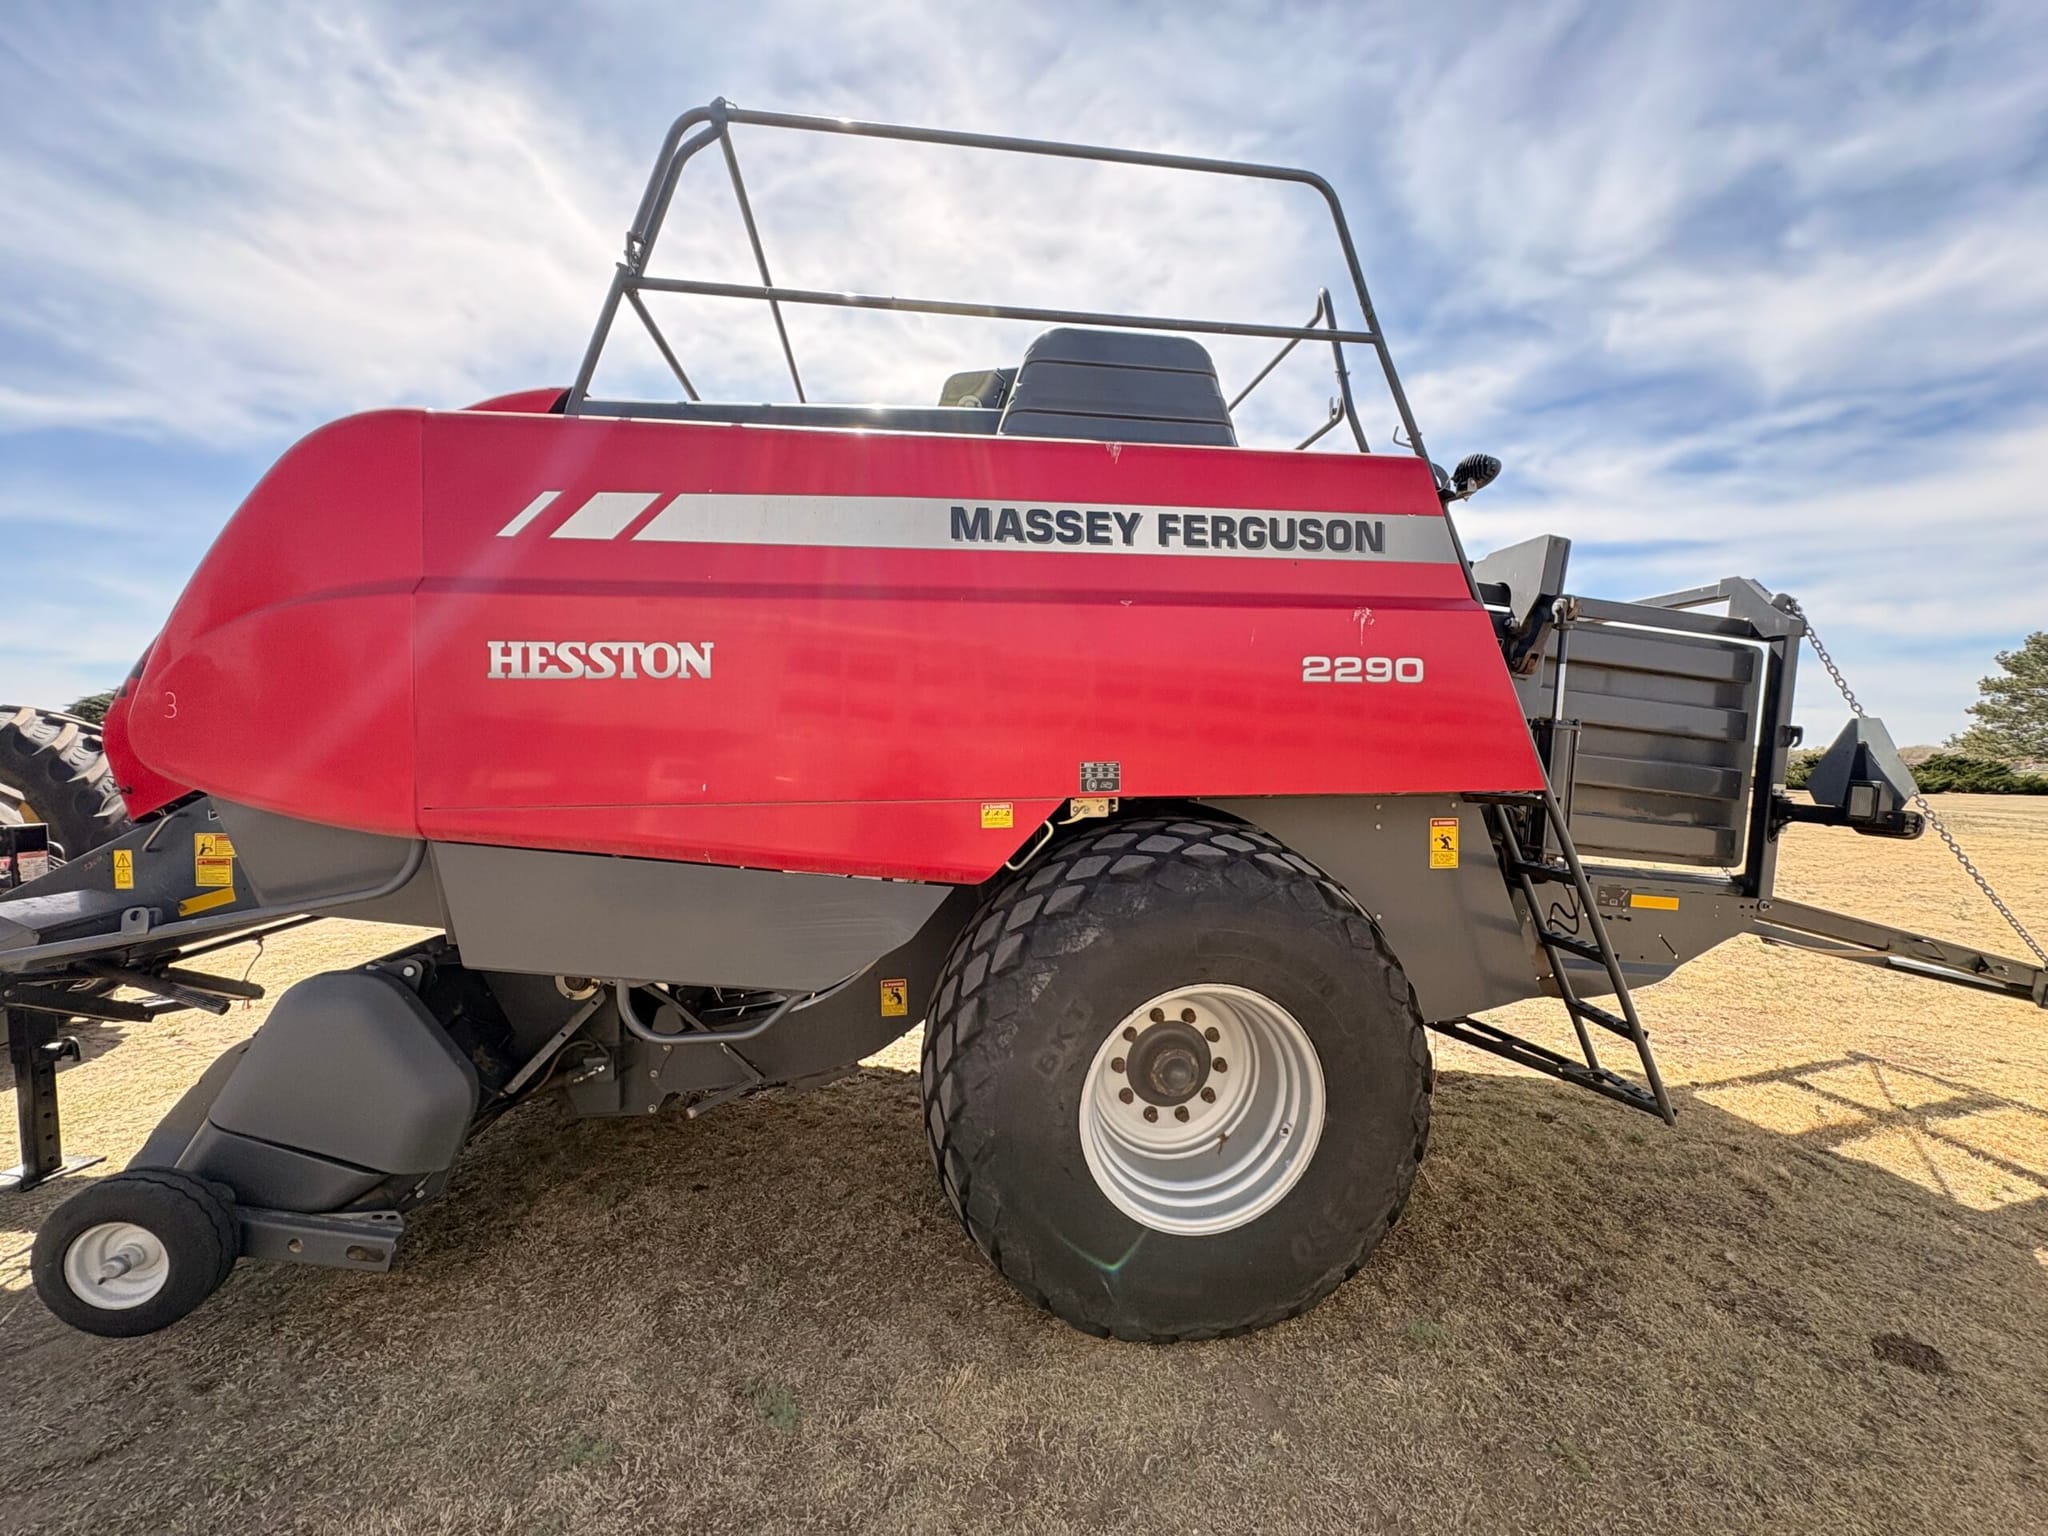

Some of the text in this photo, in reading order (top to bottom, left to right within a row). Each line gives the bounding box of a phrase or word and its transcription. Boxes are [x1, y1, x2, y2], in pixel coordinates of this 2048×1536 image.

[950, 506, 1385, 553] MASSEY FERGUSON
[487, 641, 714, 679] HESSTON
[1302, 656, 1424, 683] 2290
[164, 691, 177, 719] 3
[1033, 999, 1092, 1079] BKT
